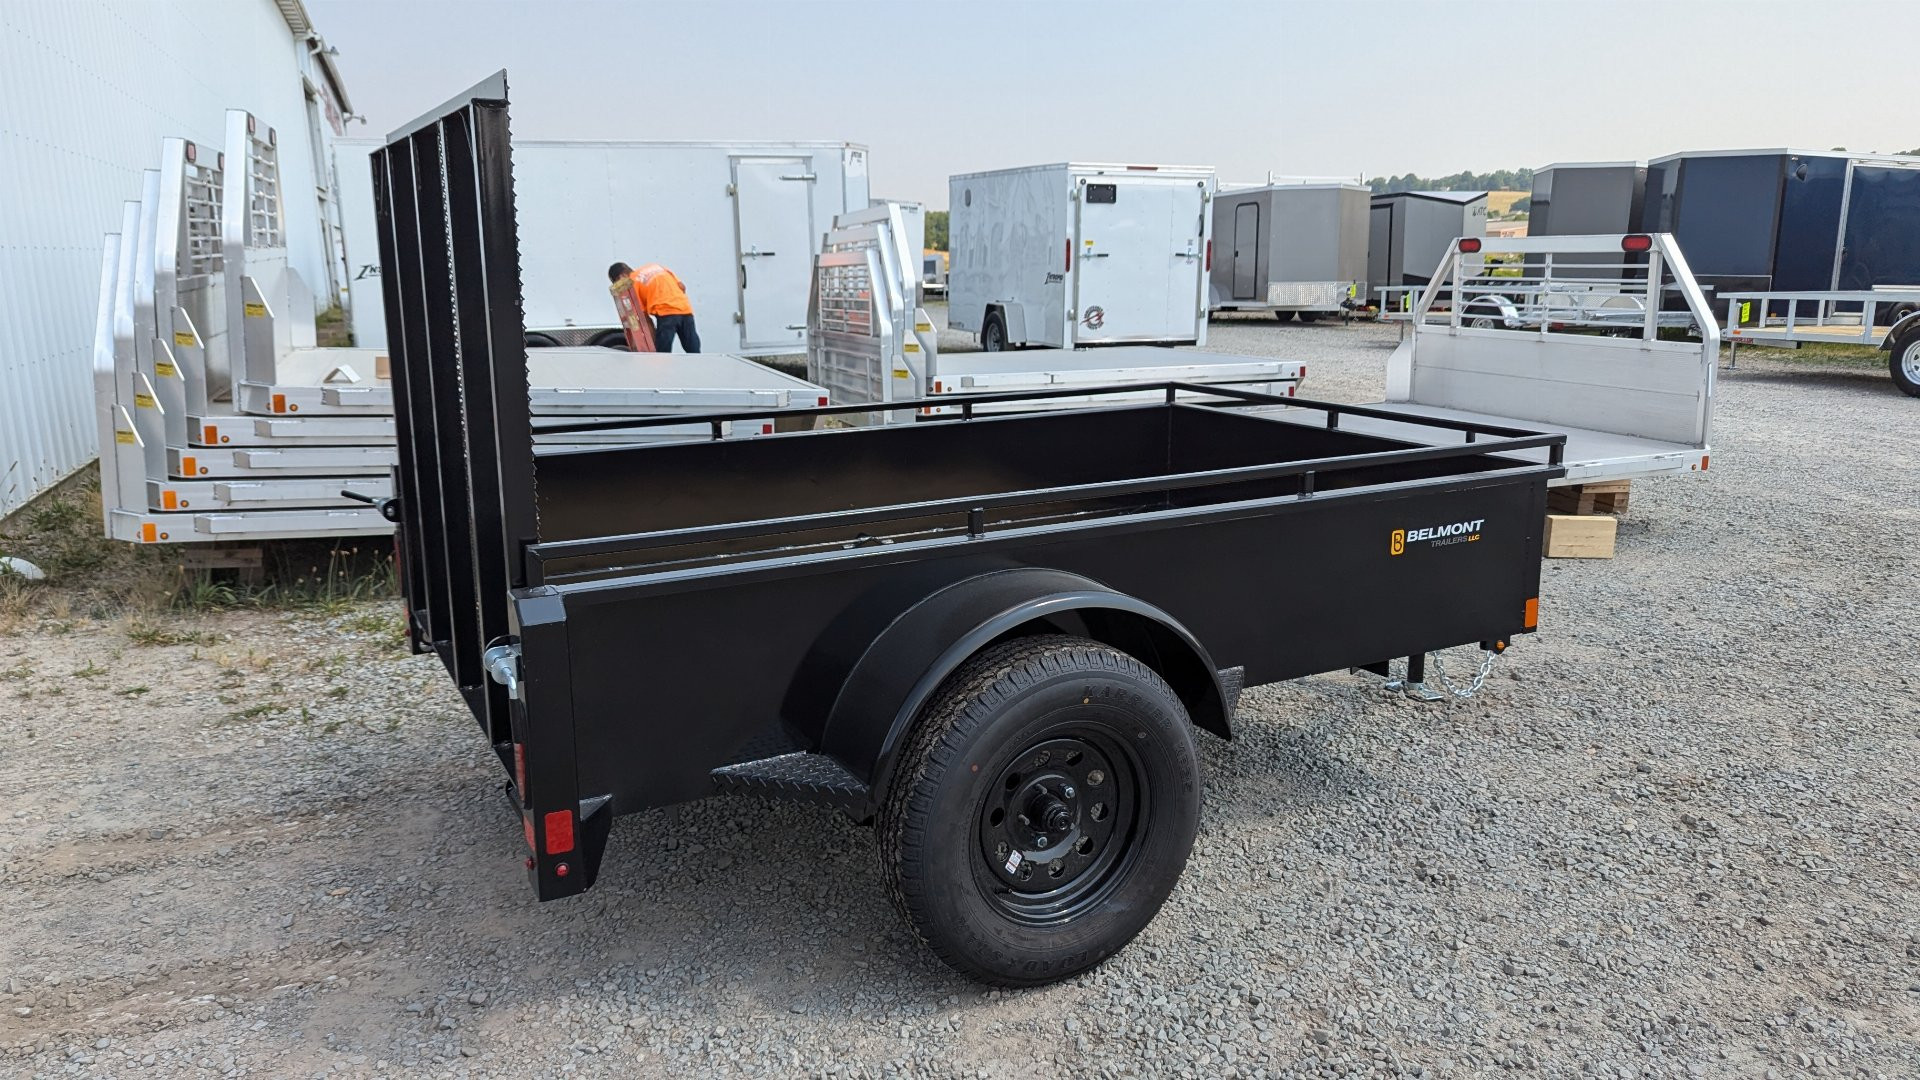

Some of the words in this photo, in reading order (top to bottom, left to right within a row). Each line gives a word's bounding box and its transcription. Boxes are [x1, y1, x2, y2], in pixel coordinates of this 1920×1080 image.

[1406, 519, 1485, 542] BELMONT
[1430, 535, 1468, 548] TRAILERS
[1468, 534, 1480, 542] LLC
